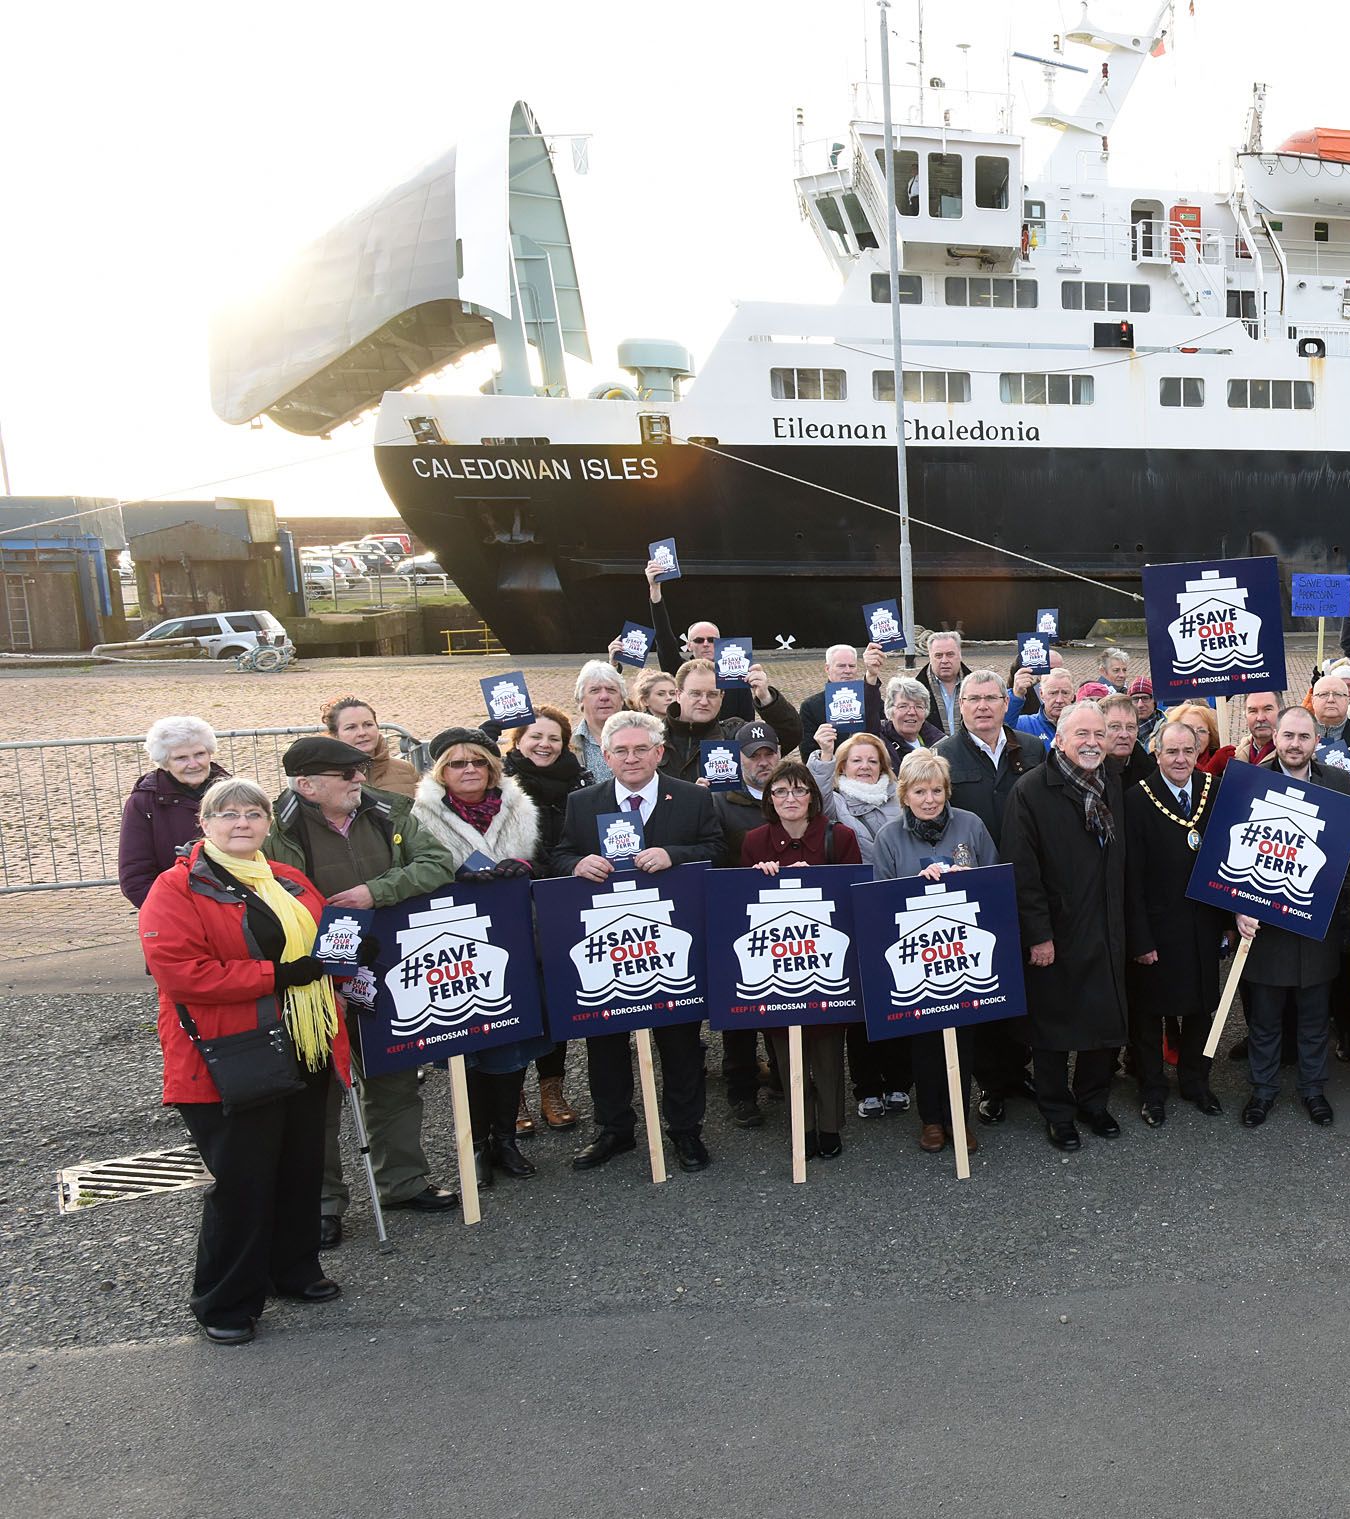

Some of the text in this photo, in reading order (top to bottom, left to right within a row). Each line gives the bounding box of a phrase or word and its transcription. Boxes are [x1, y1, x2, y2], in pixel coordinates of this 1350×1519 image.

[772, 418, 887, 439] Eileanan
[412, 458, 658, 480] CALEDONIAN ISLES
[1180, 608, 1237, 638] #SAVE
[1198, 622, 1236, 639] OUR
[1200, 632, 1248, 651] FERRY
[1241, 823, 1306, 849] #SAVE
[1258, 839, 1298, 862] OUR
[1255, 853, 1308, 878] FERRY
[585, 924, 661, 964] #SAVE
[610, 940, 659, 962] OUR
[748, 924, 820, 957] #SAVE
[771, 939, 817, 958] OUR
[899, 926, 967, 964] #SAVE
[921, 941, 966, 963] OUR
[400, 942, 477, 989] #SAVE
[426, 959, 475, 986] OUR
[613, 952, 675, 977] FERRY
[773, 953, 832, 973] FERRY
[924, 952, 980, 977] FERRY
[429, 971, 491, 1002] FERRY
